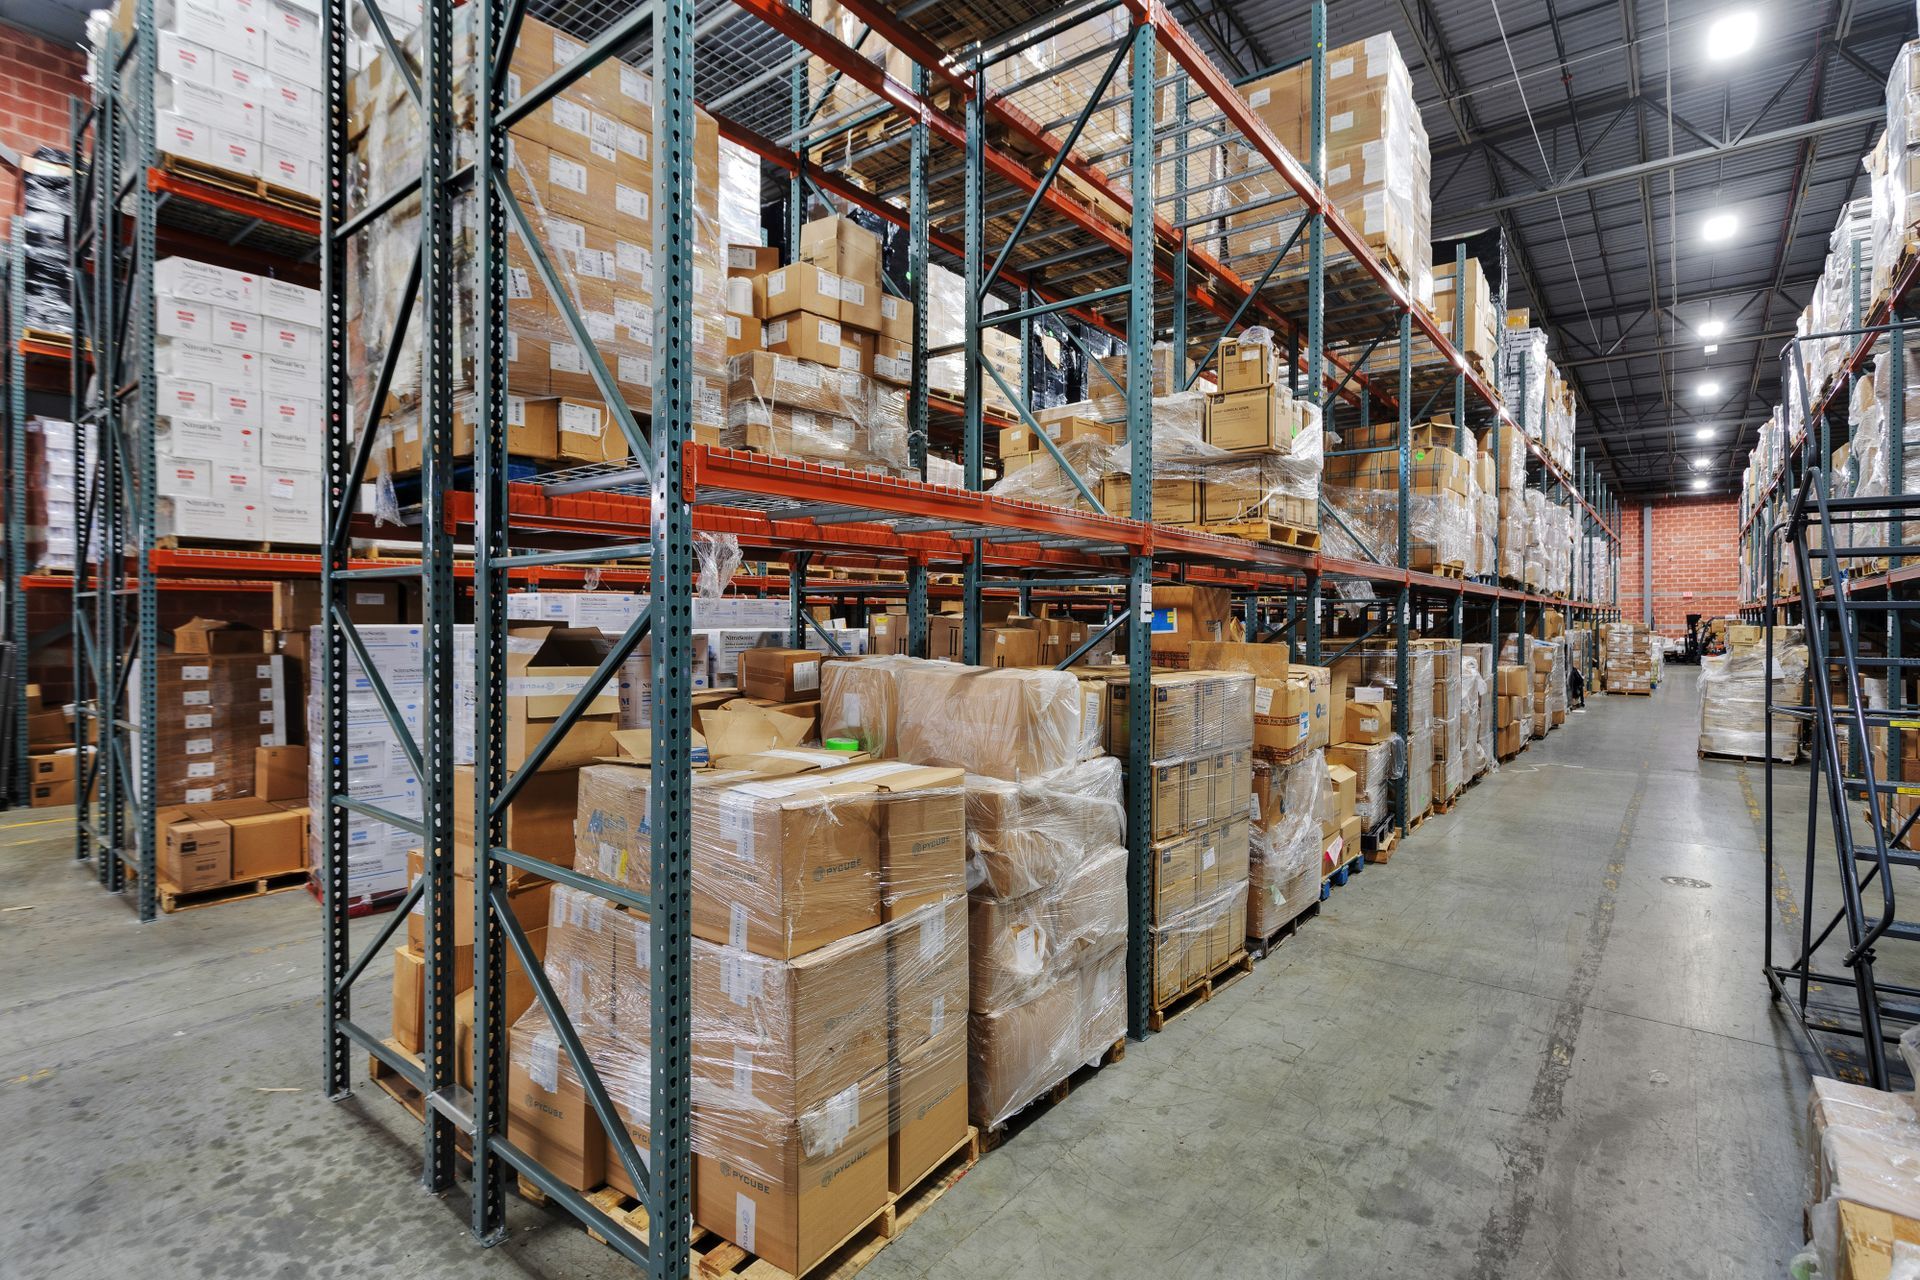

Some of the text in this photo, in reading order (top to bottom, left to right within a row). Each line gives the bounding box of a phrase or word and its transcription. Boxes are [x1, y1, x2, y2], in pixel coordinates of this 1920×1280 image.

[922, 835, 951, 851] PYCUBE
[826, 858, 862, 876] PYCUBE
[534, 1102, 564, 1120] PYCUBE
[833, 1149, 869, 1178] PYCUBE
[731, 1170, 770, 1195] PYCUBE
